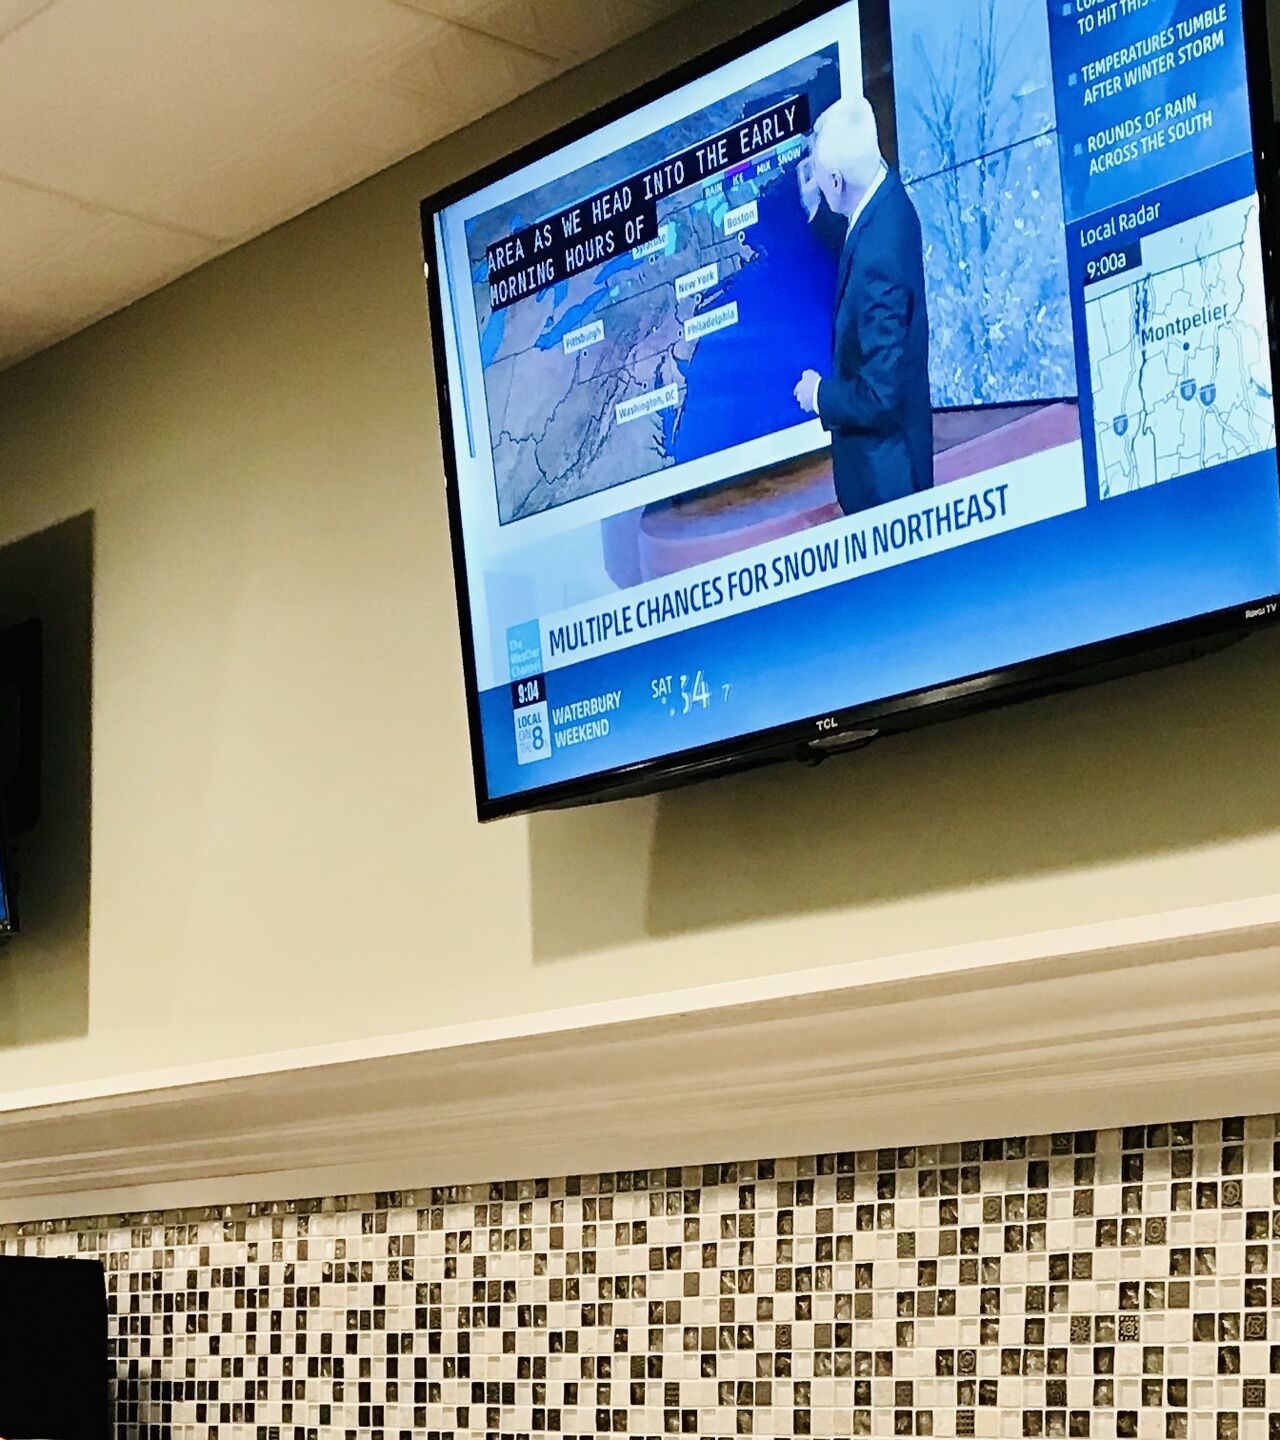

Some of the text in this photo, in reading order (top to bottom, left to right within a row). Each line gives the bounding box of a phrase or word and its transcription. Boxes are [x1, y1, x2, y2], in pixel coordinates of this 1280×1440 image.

[1077, 14, 1094, 35] TO
[1097, 3, 1117, 27] HIT
[1081, 4, 1228, 83] TEMPERATURES TUMBLE
[1083, 29, 1225, 106] AFTER WINTER STORM
[1087, 92, 1197, 152] ROUNDS OF RAIN
[777, 146, 802, 168] SNOW
[1089, 110, 1213, 176] ACROSS THE SOUTH
[732, 174, 746, 187] ICE
[756, 159, 772, 174] MIX
[487, 104, 797, 273] AREA AS WE HEAD INTO THE EARLY
[705, 181, 724, 198] RAIN
[727, 209, 755, 228] Boston
[1080, 202, 1161, 248] Local Radar
[489, 215, 645, 307] MORNING HOURS OF
[1086, 252, 1128, 280] 9:00a
[678, 272, 716, 295] New York
[687, 308, 735, 335] Philadelphia
[1141, 303, 1231, 346] Montpelier
[566, 326, 602, 349] Pittsburgh
[619, 395, 665, 419] Washington,
[548, 483, 1010, 658] MULTIPLE CHANCES FOR SNOW IN NORTHEAST
[518, 680, 539, 704] 9:04
[551, 690, 622, 726] WATERBURY
[651, 675, 673, 699] SAT
[517, 711, 542, 729] LOCAL
[554, 718, 610, 749] WEEKEND
[815, 716, 839, 732] TCL
